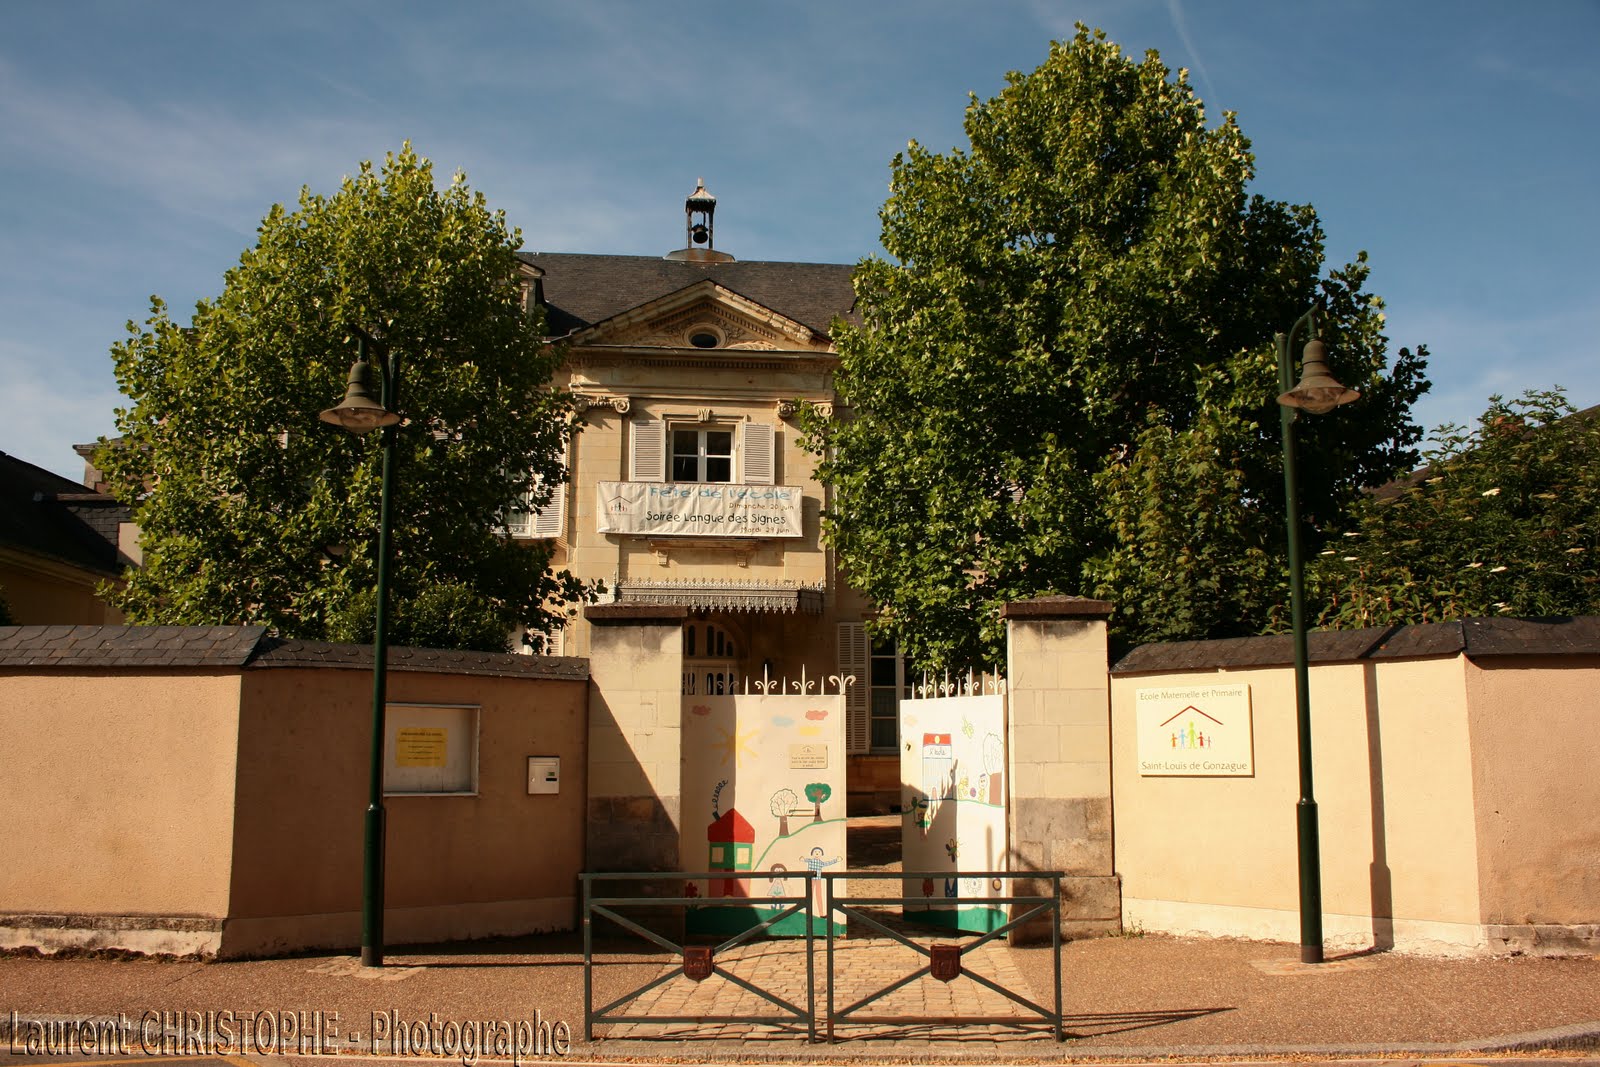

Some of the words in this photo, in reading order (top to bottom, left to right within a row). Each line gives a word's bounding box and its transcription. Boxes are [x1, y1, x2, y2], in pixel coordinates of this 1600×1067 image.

[698, 488, 722, 499] de
[646, 511, 680, 523] Soirée
[684, 512, 724, 524] Langue
[728, 513, 748, 524] des
[751, 514, 786, 525] Signes
[1160, 690, 1200, 699] Maternelle
[1211, 688, 1242, 697] Primaire
[1141, 761, 1187, 770] Saint-Louis
[1189, 761, 1200, 770] de
[1203, 761, 1247, 772] Gonzague
